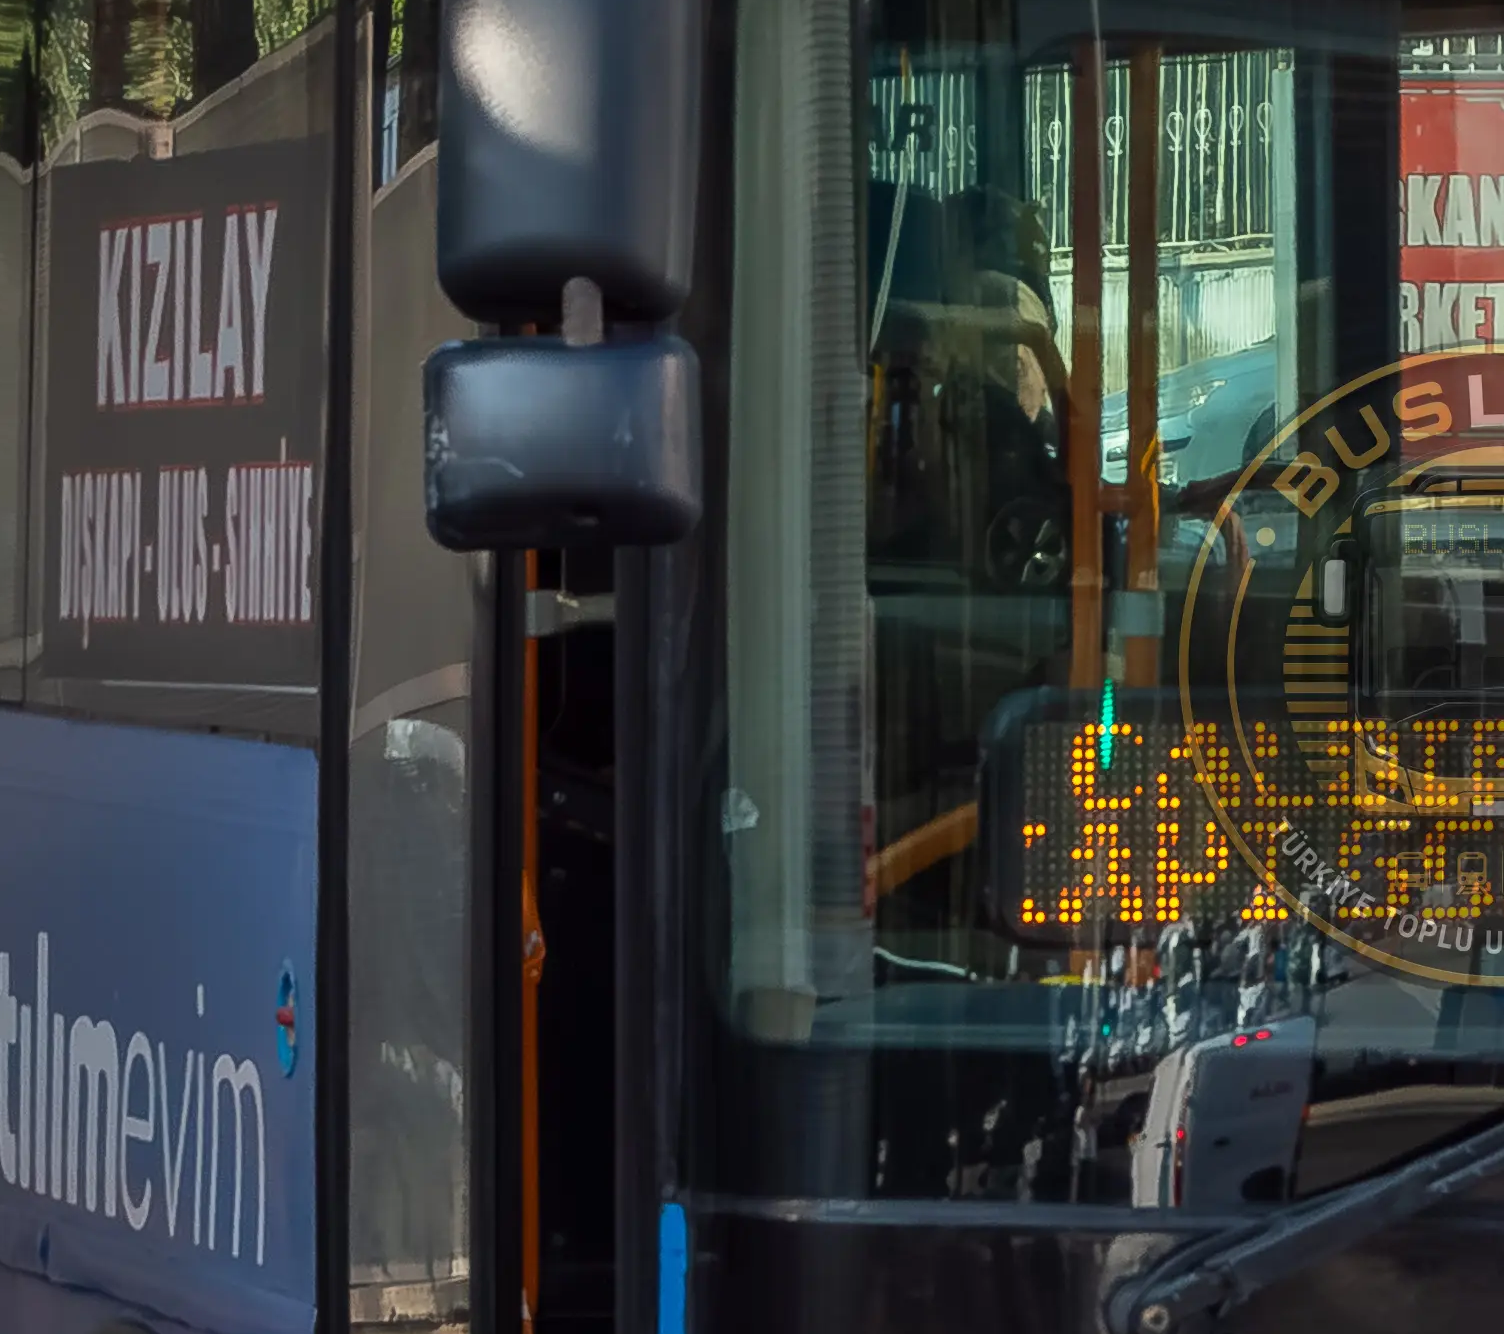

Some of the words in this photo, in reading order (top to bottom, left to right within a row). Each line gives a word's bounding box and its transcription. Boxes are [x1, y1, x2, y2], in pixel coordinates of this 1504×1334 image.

[96, 200, 279, 411] KIZILAY
[59, 470, 142, 650] DIŞKAPI
[157, 465, 208, 623] ULUS
